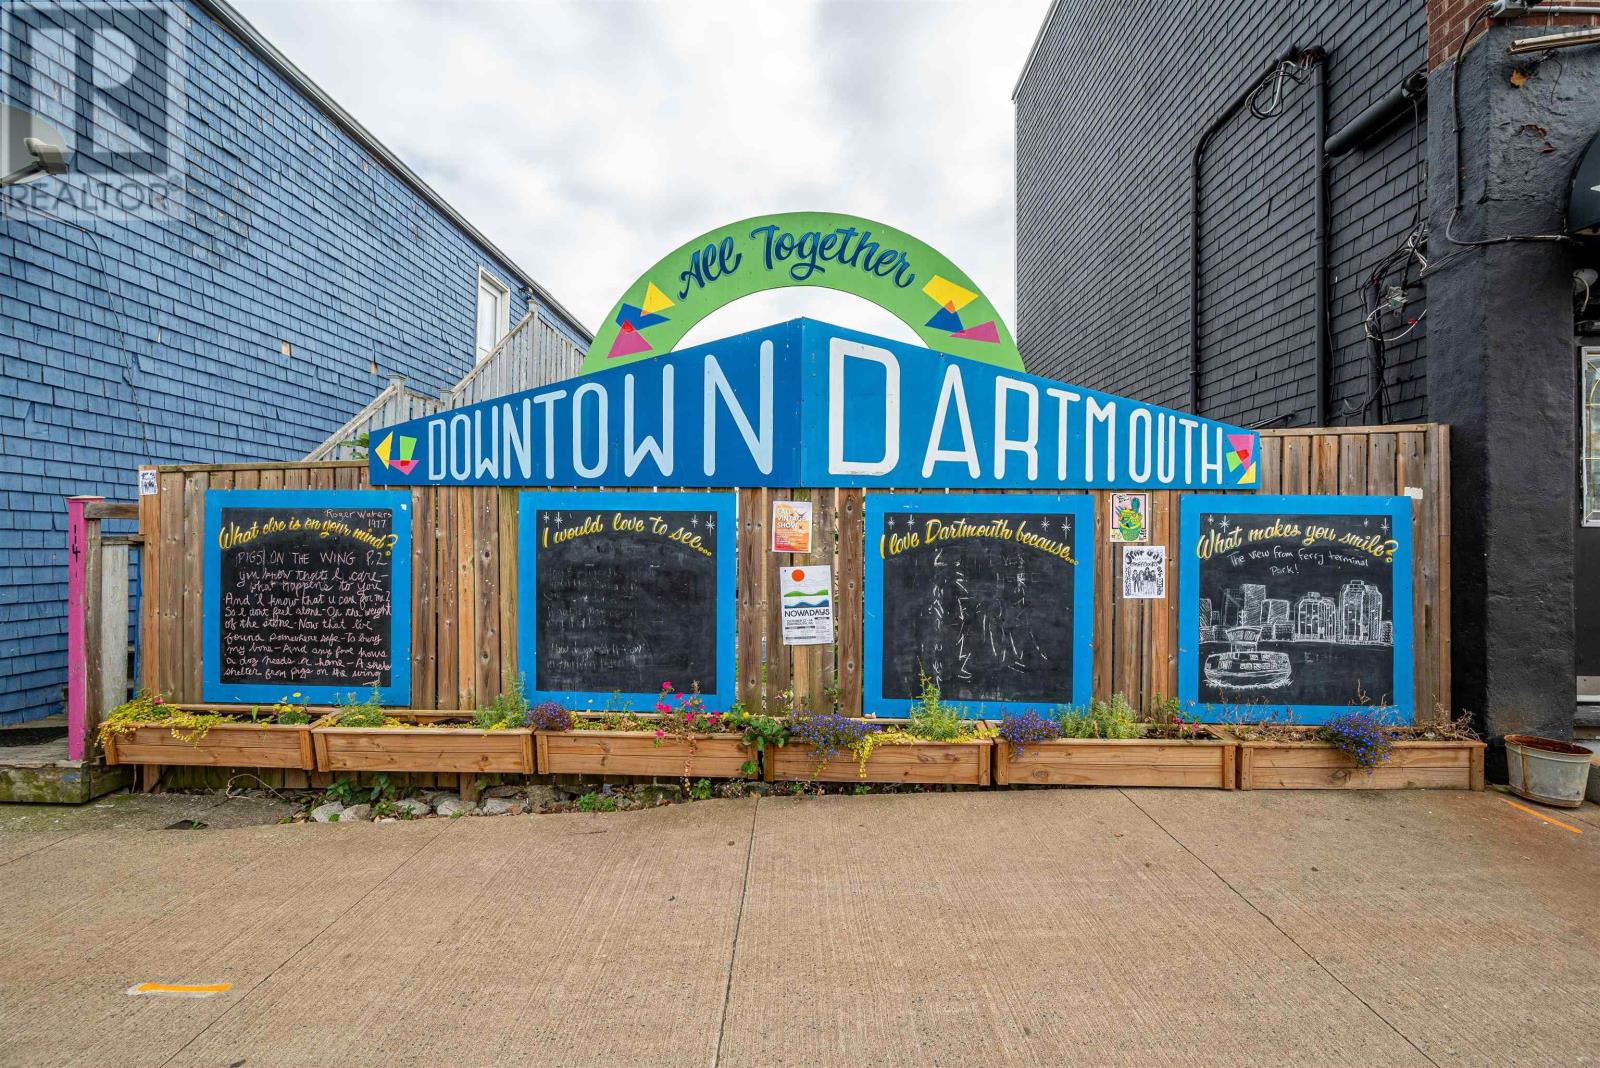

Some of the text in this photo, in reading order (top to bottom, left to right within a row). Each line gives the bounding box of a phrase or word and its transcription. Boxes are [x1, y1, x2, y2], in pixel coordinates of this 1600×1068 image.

[677, 224, 916, 301] All Together
[428, 336, 1223, 485] DOWNTOWN DARTMOUTH
[326, 509, 392, 522] Roger Waters
[218, 517, 398, 557] What else is on your mind?
[542, 512, 713, 558] I would love to see...
[879, 517, 1080, 567] I love Dartmouth because...
[1196, 525, 1243, 560] What
[1247, 518, 1302, 542] makes
[1301, 524, 1336, 546] you
[1338, 532, 1399, 564] smile?
[270, 550, 285, 565] ON
[292, 552, 310, 564] THE
[320, 551, 356, 566] WING
[1227, 550, 1246, 566] The
[1328, 551, 1368, 567] terminal
[1269, 564, 1299, 576] Park!
[339, 580, 353, 591] to
[357, 582, 382, 594] you
[225, 592, 250, 606] And
[270, 594, 300, 607] know
[302, 594, 324, 605] that
[225, 607, 236, 617] So
[365, 604, 391, 619] weight
[784, 608, 831, 617] NOWADAYS
[224, 618, 236, 630] of
[240, 617, 259, 628] the
[322, 618, 347, 630] that
[224, 632, 265, 645] found
[239, 656, 258, 667] dog
[262, 656, 295, 665] needs
[224, 667, 381, 681] shelter from pigs on the wing
